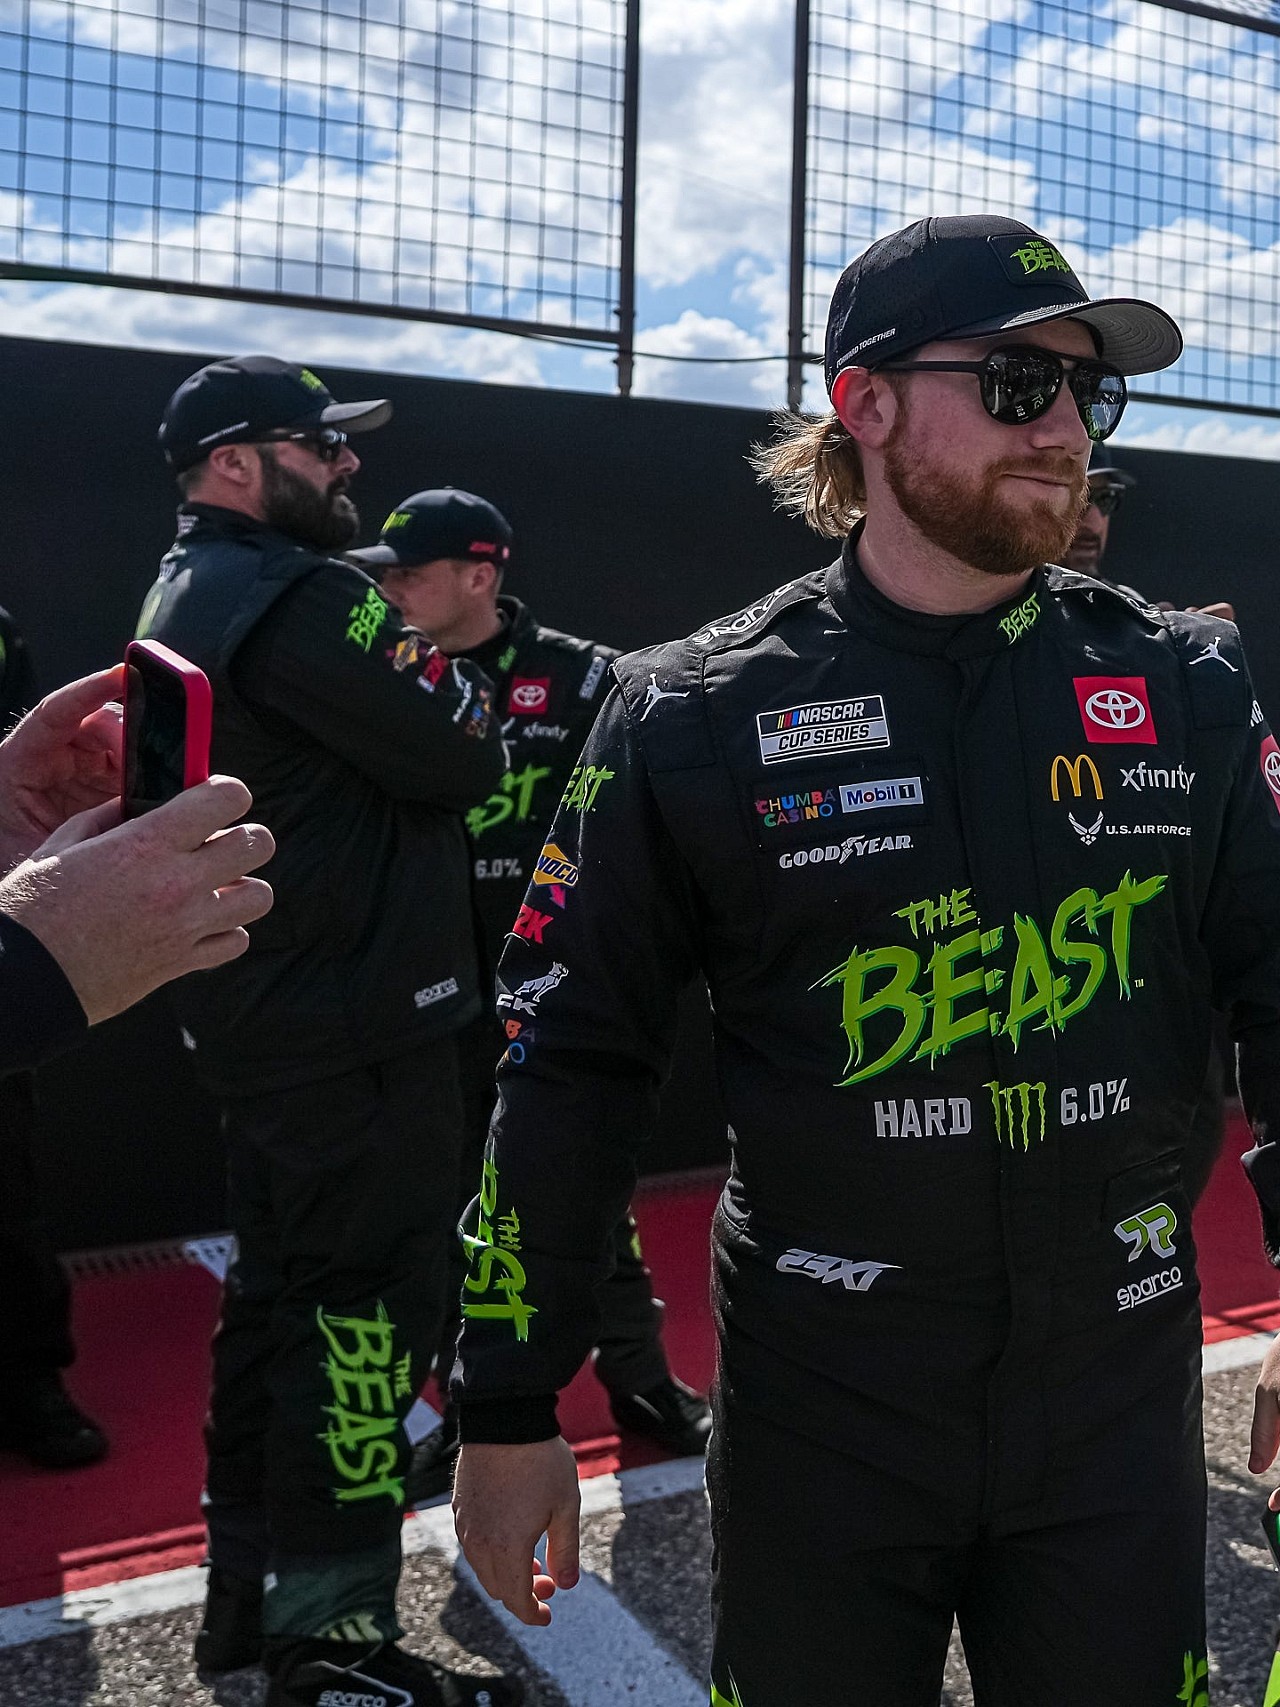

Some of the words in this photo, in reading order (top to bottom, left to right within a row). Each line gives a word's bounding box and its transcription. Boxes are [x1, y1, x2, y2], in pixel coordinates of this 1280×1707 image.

[1025, 241, 1045, 249] THE
[859, 328, 896, 350] TOGETHER
[997, 591, 1041, 646] BEAST
[797, 701, 865, 725] NASCAR
[778, 731, 812, 751] CUP
[813, 724, 870, 745] SERIES
[1119, 761, 1196, 795] xfinity
[754, 788, 837, 815] CHUMBA
[846, 785, 897, 806] Mobil
[763, 803, 834, 828] CASINO
[1105, 825, 1132, 835] U.S.
[1133, 825, 1156, 835] AIR
[1157, 825, 1192, 837] FORCE
[474, 858, 523, 880] 6.0%
[891, 887, 980, 940] THE
[807, 868, 1169, 1087] BEAST
[874, 1097, 973, 1138] HARD
[1059, 1077, 1131, 1126] 6.0%
[1116, 1265, 1184, 1311] sparco
[315, 1298, 406, 1506] BEAST
